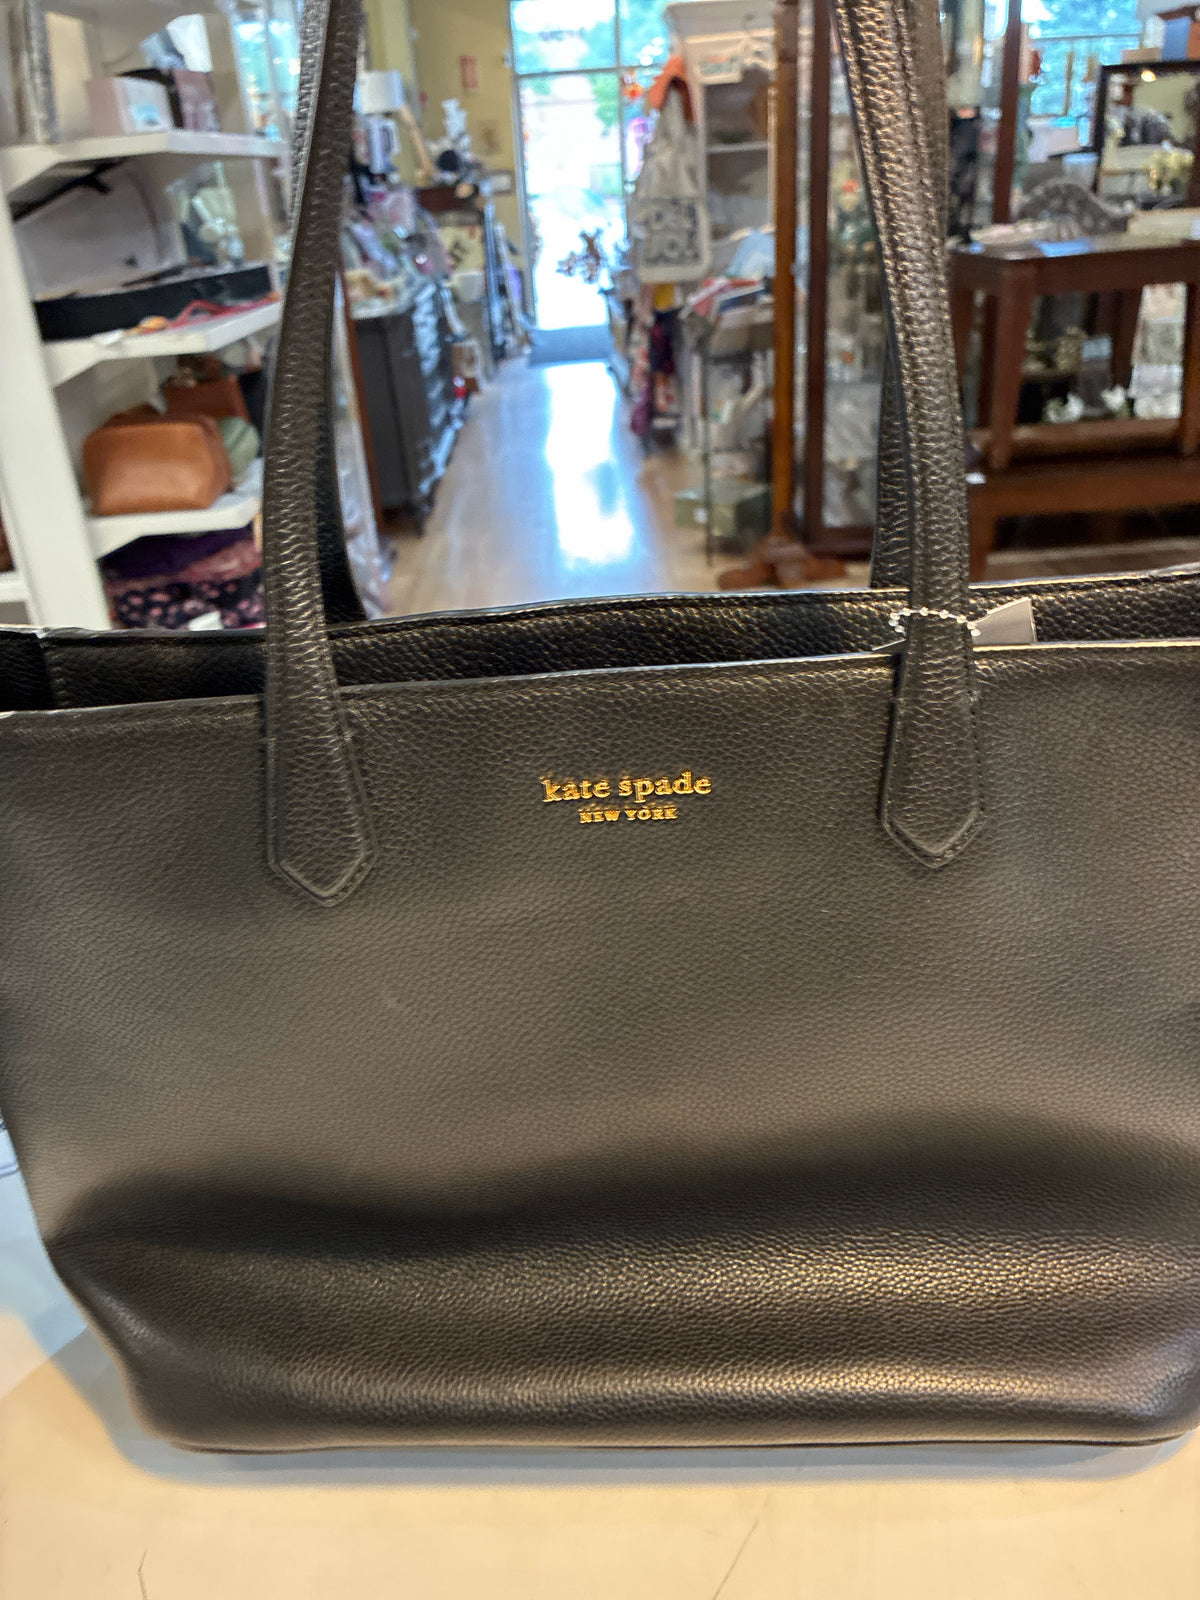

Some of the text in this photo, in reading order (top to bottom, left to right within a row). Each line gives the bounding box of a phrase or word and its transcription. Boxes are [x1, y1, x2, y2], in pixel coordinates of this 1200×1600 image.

[540, 770, 712, 803] kate spade
[578, 805, 678, 824] NEW YORK
